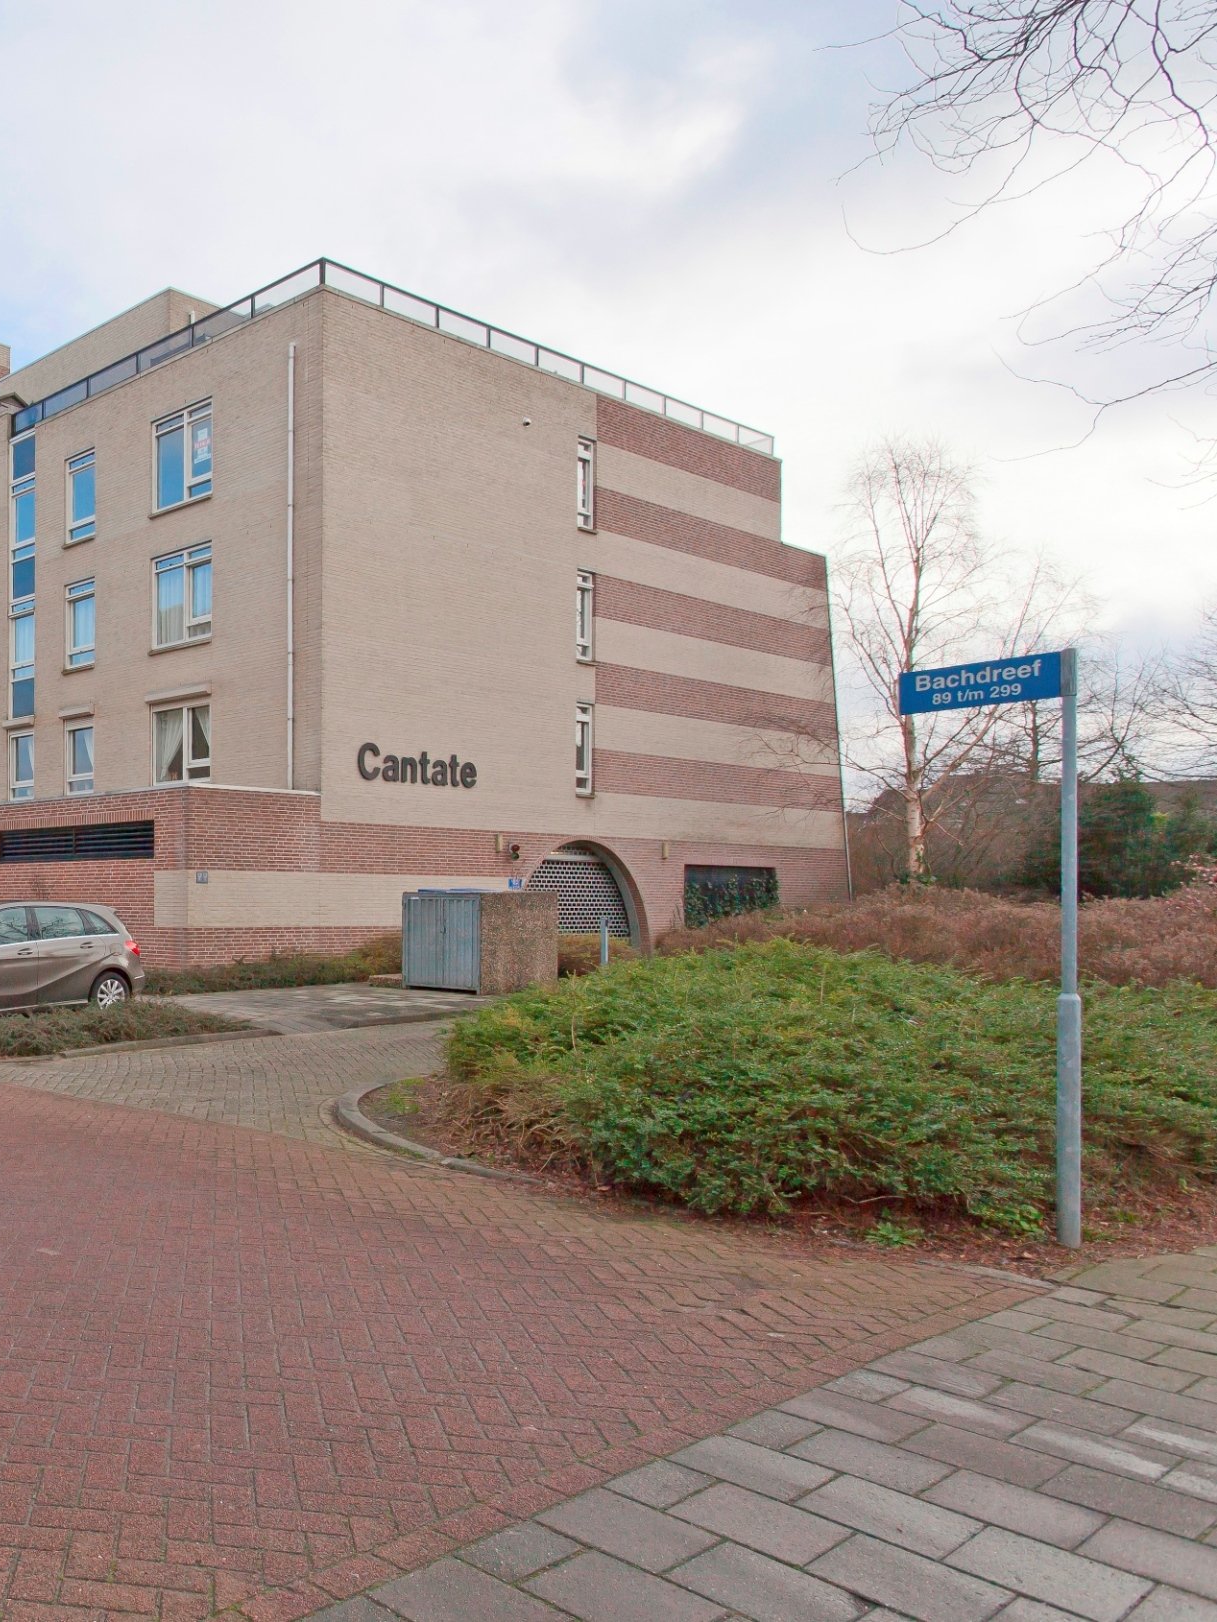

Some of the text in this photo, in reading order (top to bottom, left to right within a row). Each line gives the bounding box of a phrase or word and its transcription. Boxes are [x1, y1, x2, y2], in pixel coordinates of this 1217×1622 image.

[915, 659, 1042, 692] Bachdreef
[932, 683, 1022, 705] 89 t/m 299
[357, 742, 478, 789] Cantate
